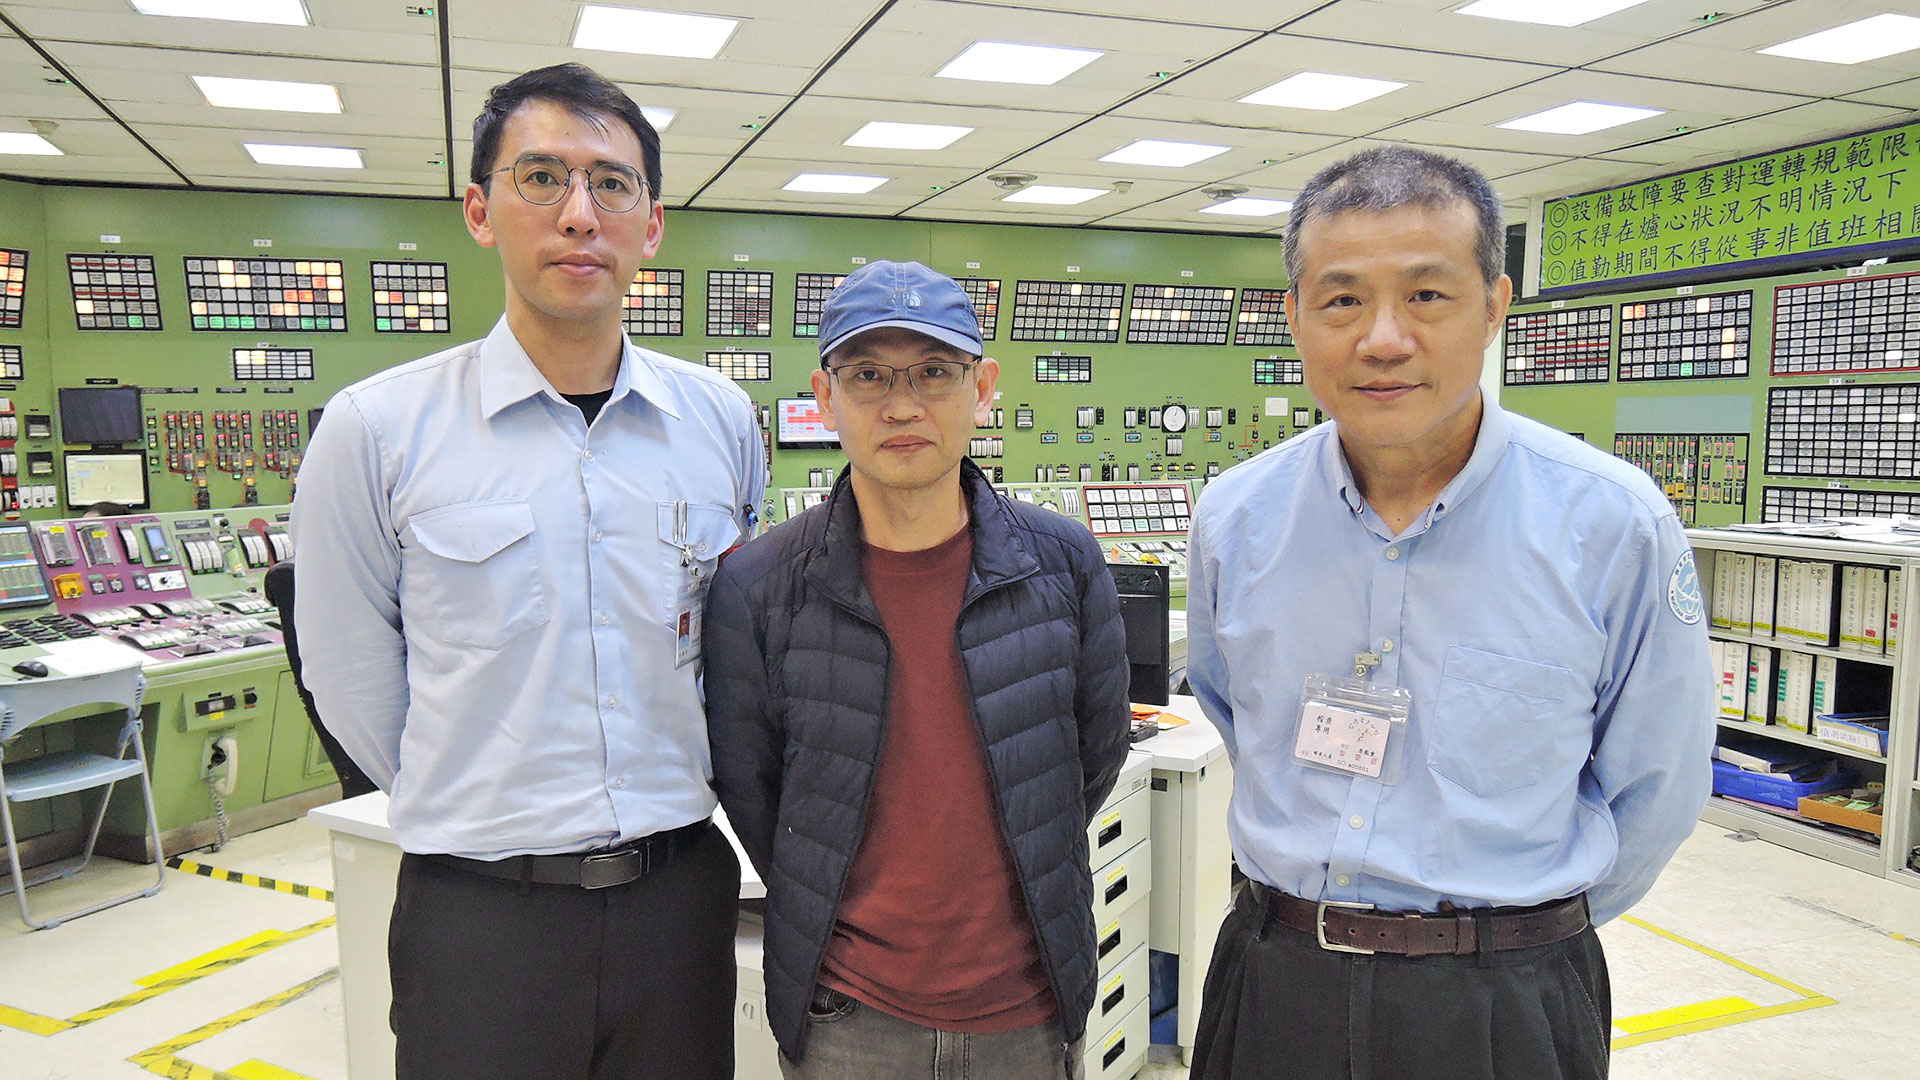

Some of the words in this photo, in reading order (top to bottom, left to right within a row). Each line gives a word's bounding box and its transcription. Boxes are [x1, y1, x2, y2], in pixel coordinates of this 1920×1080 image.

[1570, 169, 1907, 251] 不得在爐心狀況不明情況下
[1571, 132, 1920, 222] 設備故障要查對運轉規範限
